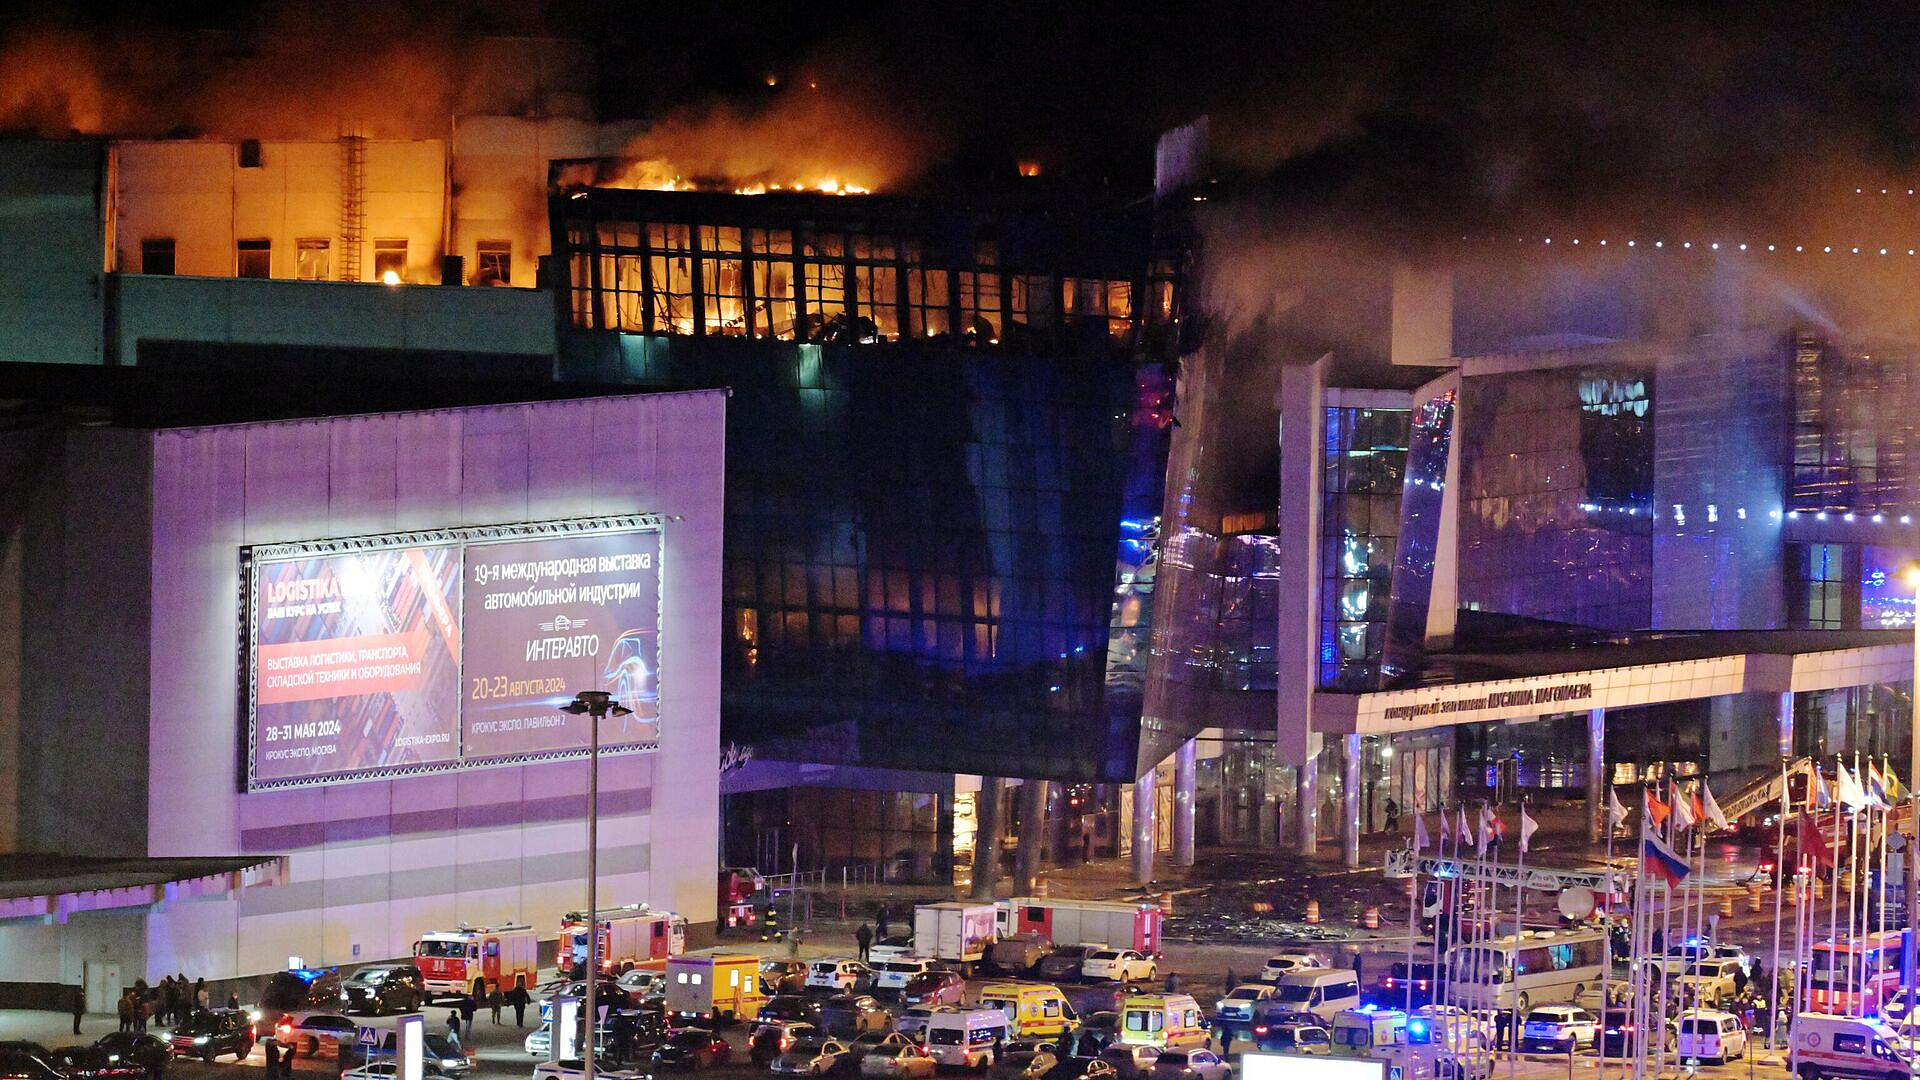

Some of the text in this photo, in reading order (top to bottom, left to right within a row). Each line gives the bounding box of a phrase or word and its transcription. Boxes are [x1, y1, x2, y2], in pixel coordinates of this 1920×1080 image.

[474, 552, 651, 585] 19-я международная выставка
[267, 577, 341, 603] LOGISTIKA
[484, 582, 641, 610] автомобильной индустрии
[286, 605, 305, 618] КУРС
[306, 604, 316, 616] НА
[526, 634, 599, 662] ИНТЕРАВТО
[267, 655, 308, 671] ВЫСТАВКА
[267, 661, 421, 688] СКЛАДСКОЙ ТЕХНИКИ И ОБОРУДОВАНИЯ
[472, 676, 566, 700] 20-23 АВГУСТА 2024
[1535, 683, 1592, 704] МАГОМАЕВА
[294, 722, 316, 739] МАЯ
[317, 719, 342, 736] 2024
[471, 721, 498, 734] КРОКУС
[524, 715, 561, 729] ПАВИЛЬОН
[561, 714, 566, 726] 2
[265, 749, 289, 760] КРОКУС
[312, 744, 337, 757] МОСКВА
